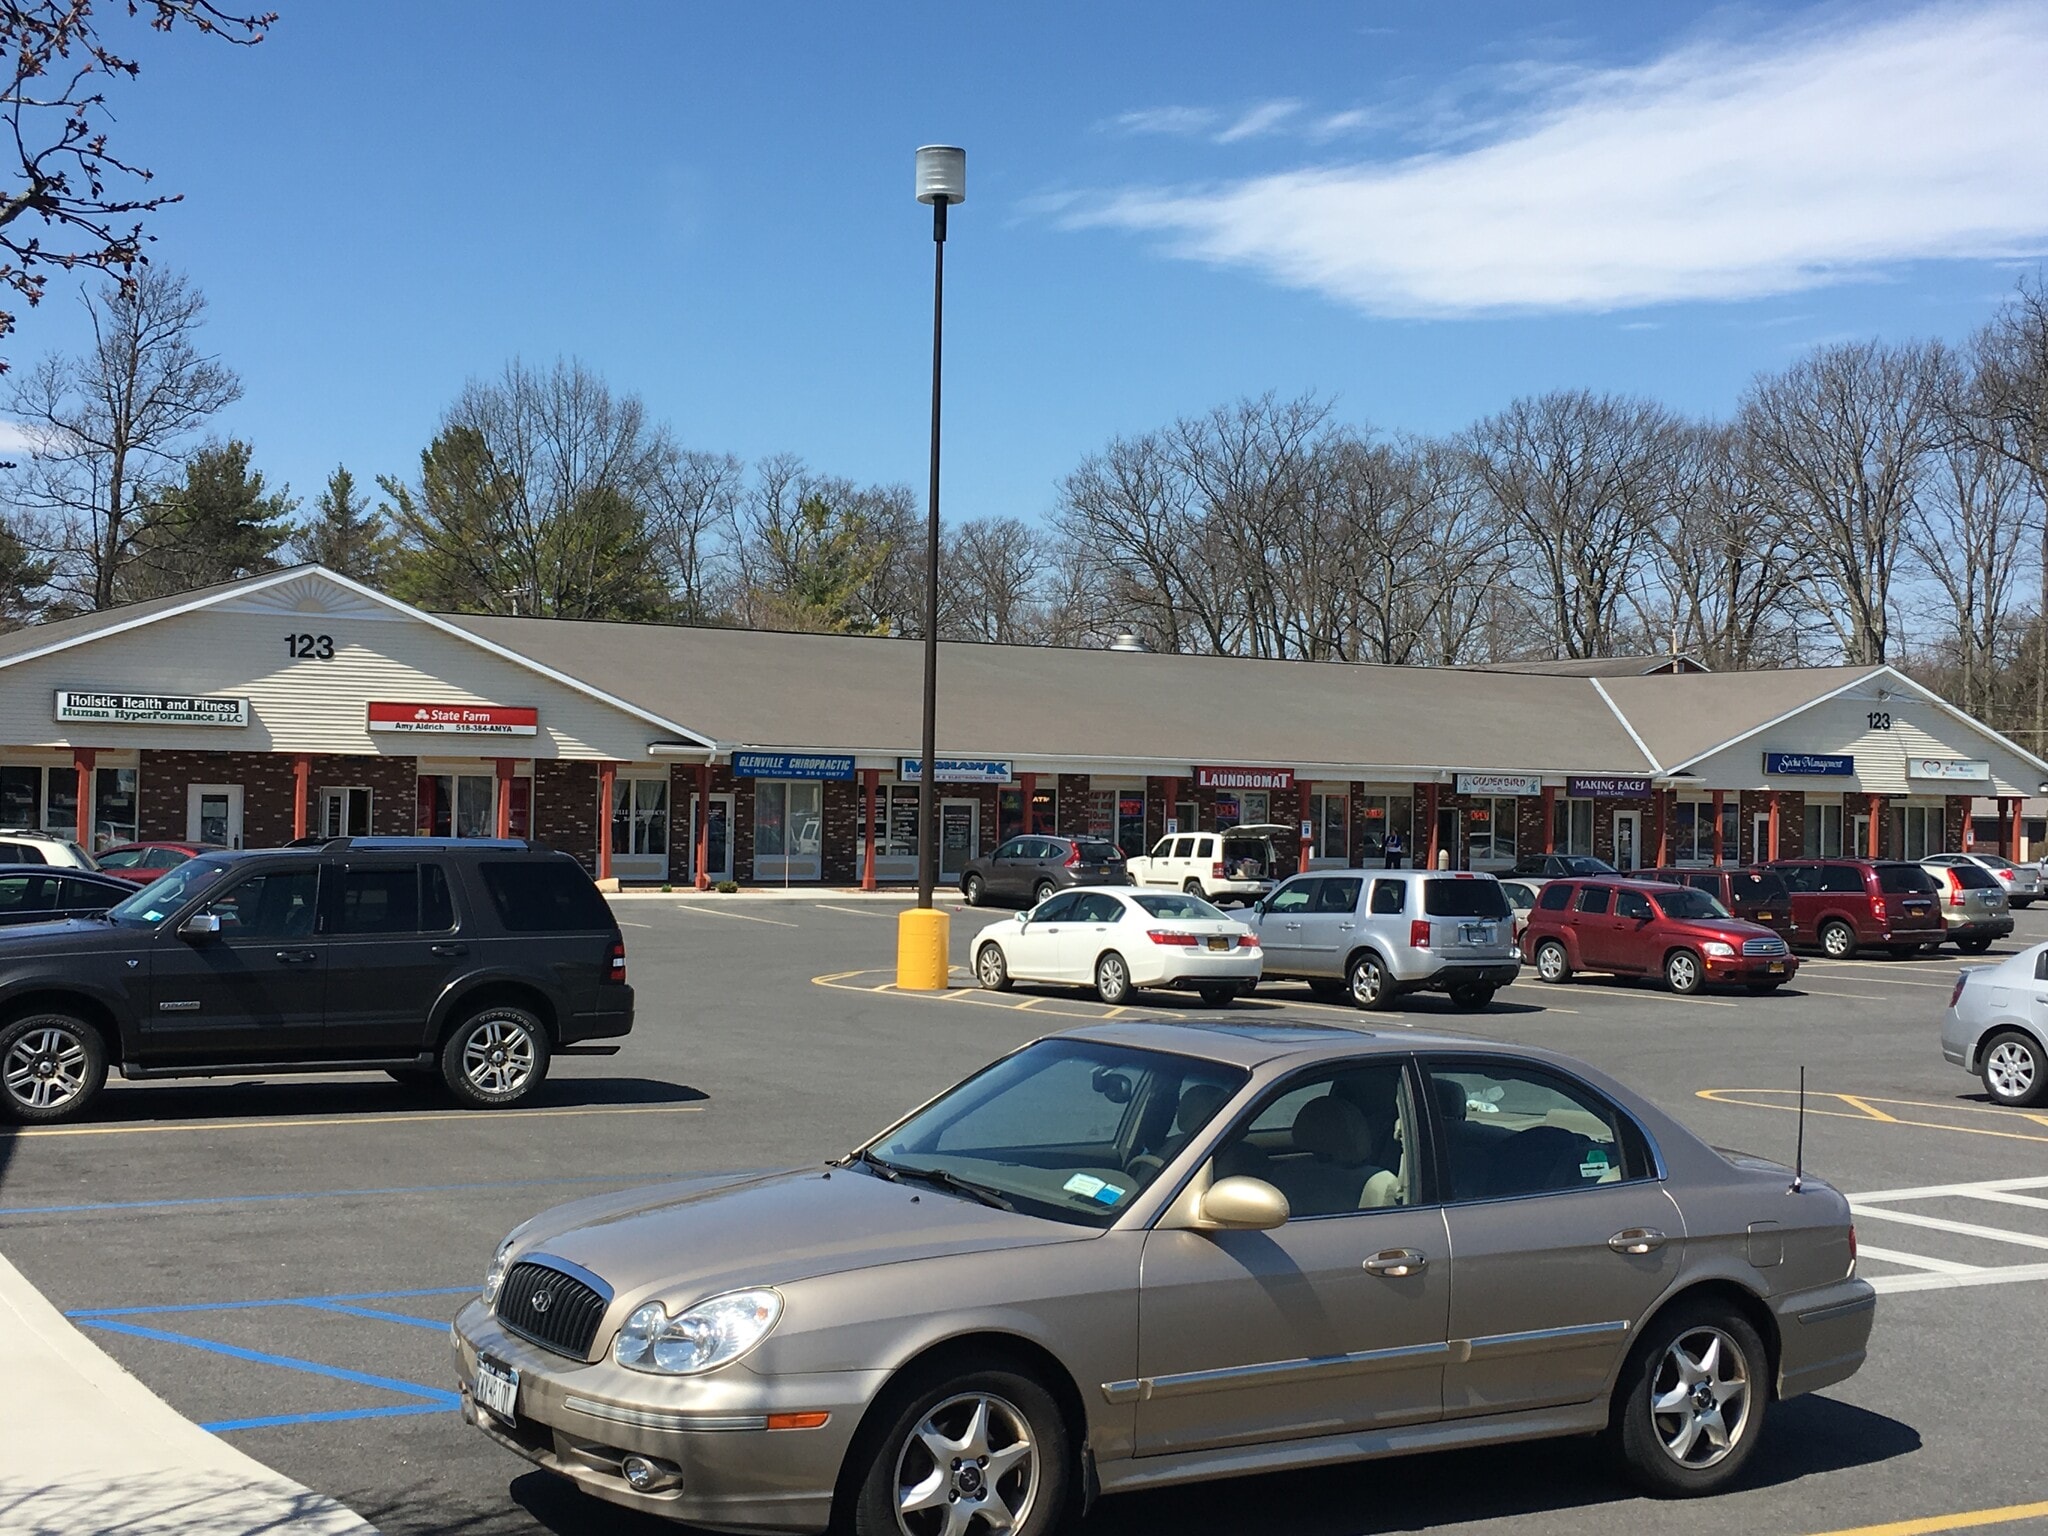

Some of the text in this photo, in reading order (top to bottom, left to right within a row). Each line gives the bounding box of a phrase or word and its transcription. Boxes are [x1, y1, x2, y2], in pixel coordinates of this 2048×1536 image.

[284, 634, 335, 659] 123
[70, 695, 237, 712] Holistic Health and Fitness
[62, 707, 109, 718] Human
[218, 713, 243, 723] LLC
[431, 710, 490, 721] State Farm
[1867, 712, 1890, 729] 123
[395, 722, 512, 732] Amy Aldrich 518-384-AMYA
[739, 756, 851, 770] GLENVILLE CHIROPRACTIC
[1200, 770, 1291, 788] LAUNDROMAT
[1575, 780, 1646, 791] MAKING FACES
